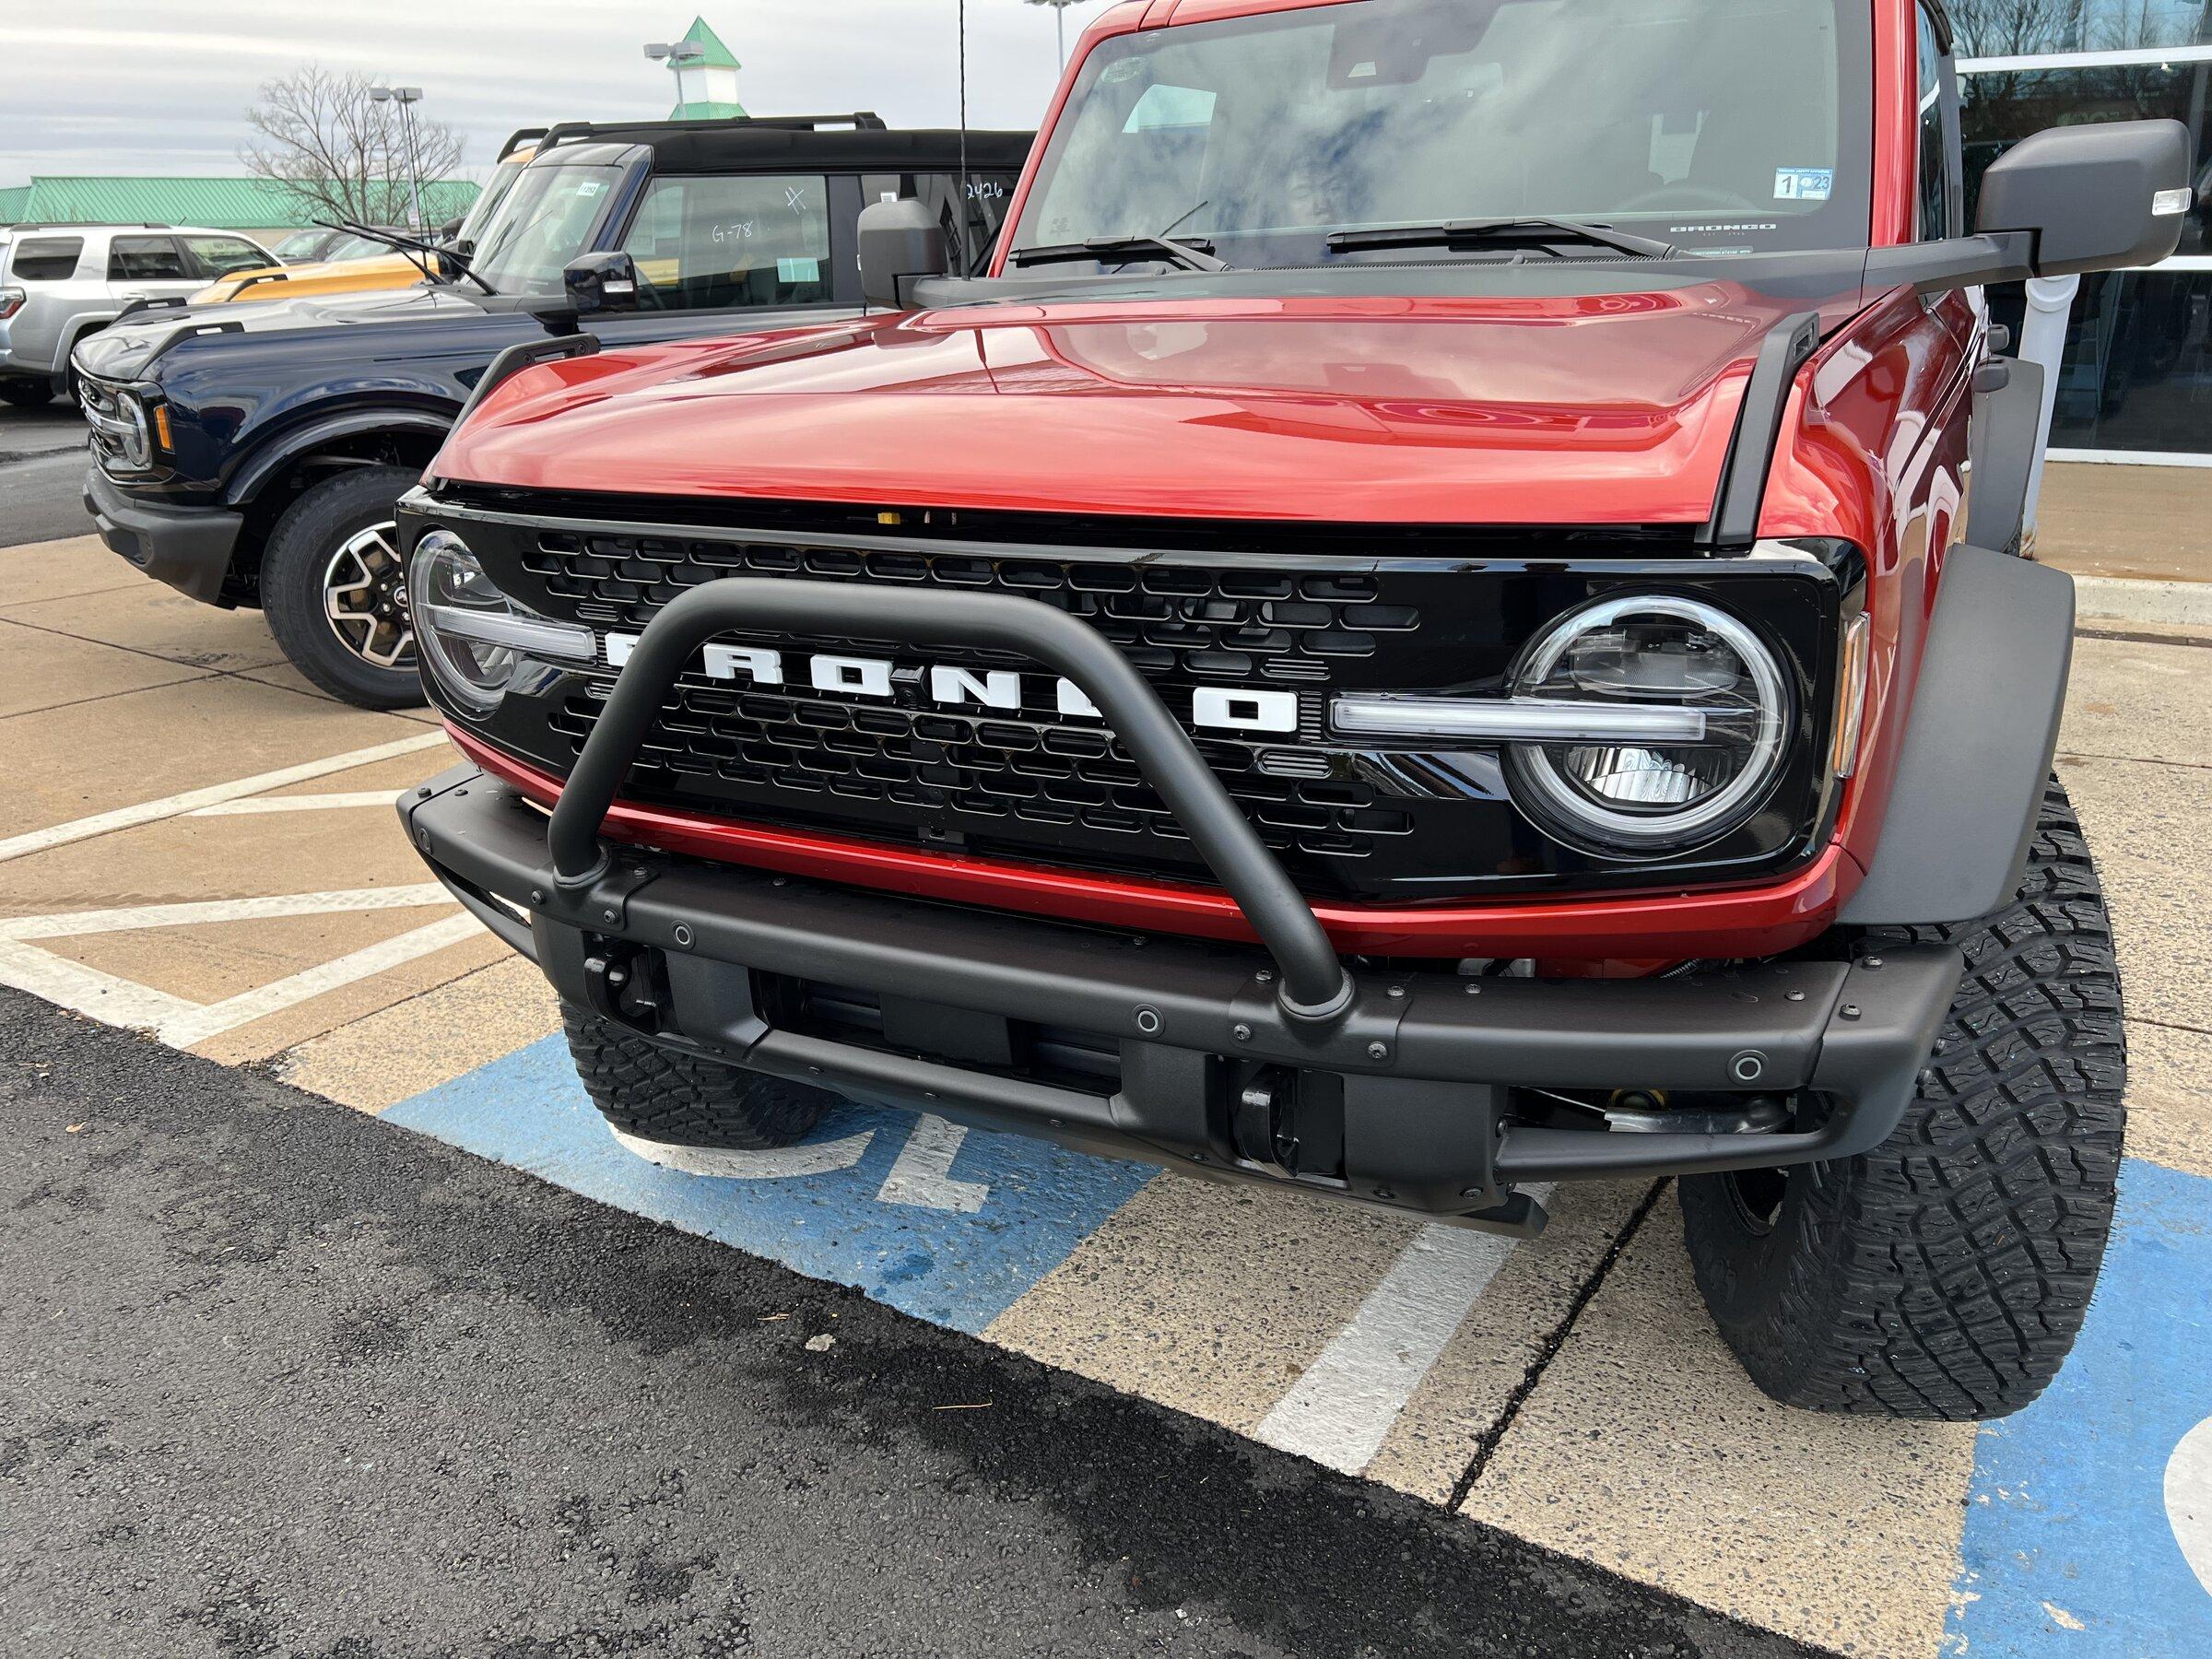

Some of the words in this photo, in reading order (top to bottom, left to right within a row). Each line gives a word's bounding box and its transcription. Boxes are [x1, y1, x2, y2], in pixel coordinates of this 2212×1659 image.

[966, 182, 1004, 200] 2426
[1781, 175, 1792, 194] 1
[1813, 176, 1830, 190] 23
[712, 220, 754, 242] G-78
